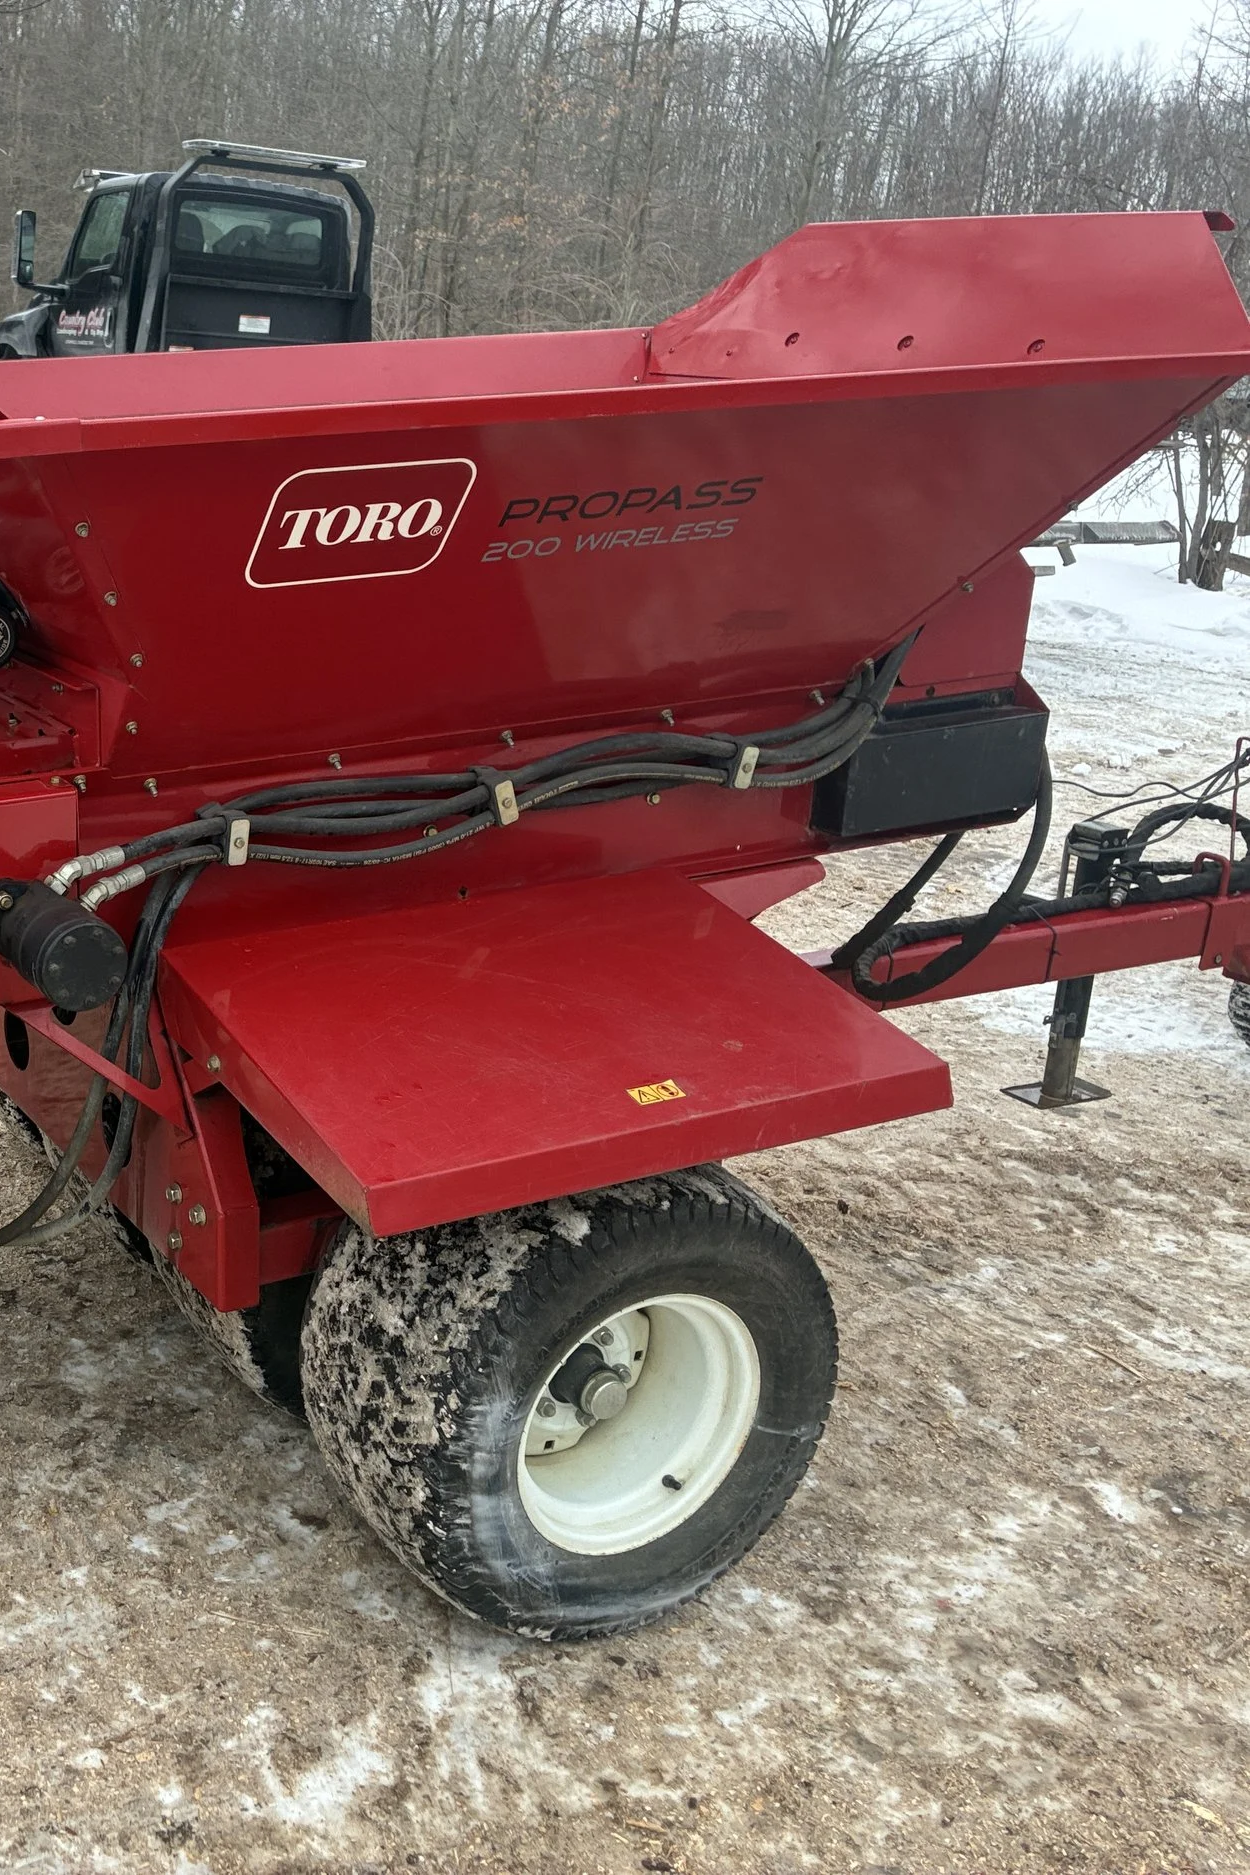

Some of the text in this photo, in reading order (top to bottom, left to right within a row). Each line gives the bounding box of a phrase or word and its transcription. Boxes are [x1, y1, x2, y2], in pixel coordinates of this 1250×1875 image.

[277, 498, 442, 550] TORO
[498, 476, 764, 528] PROPASS
[480, 518, 739, 562] 200 WIRELESS
